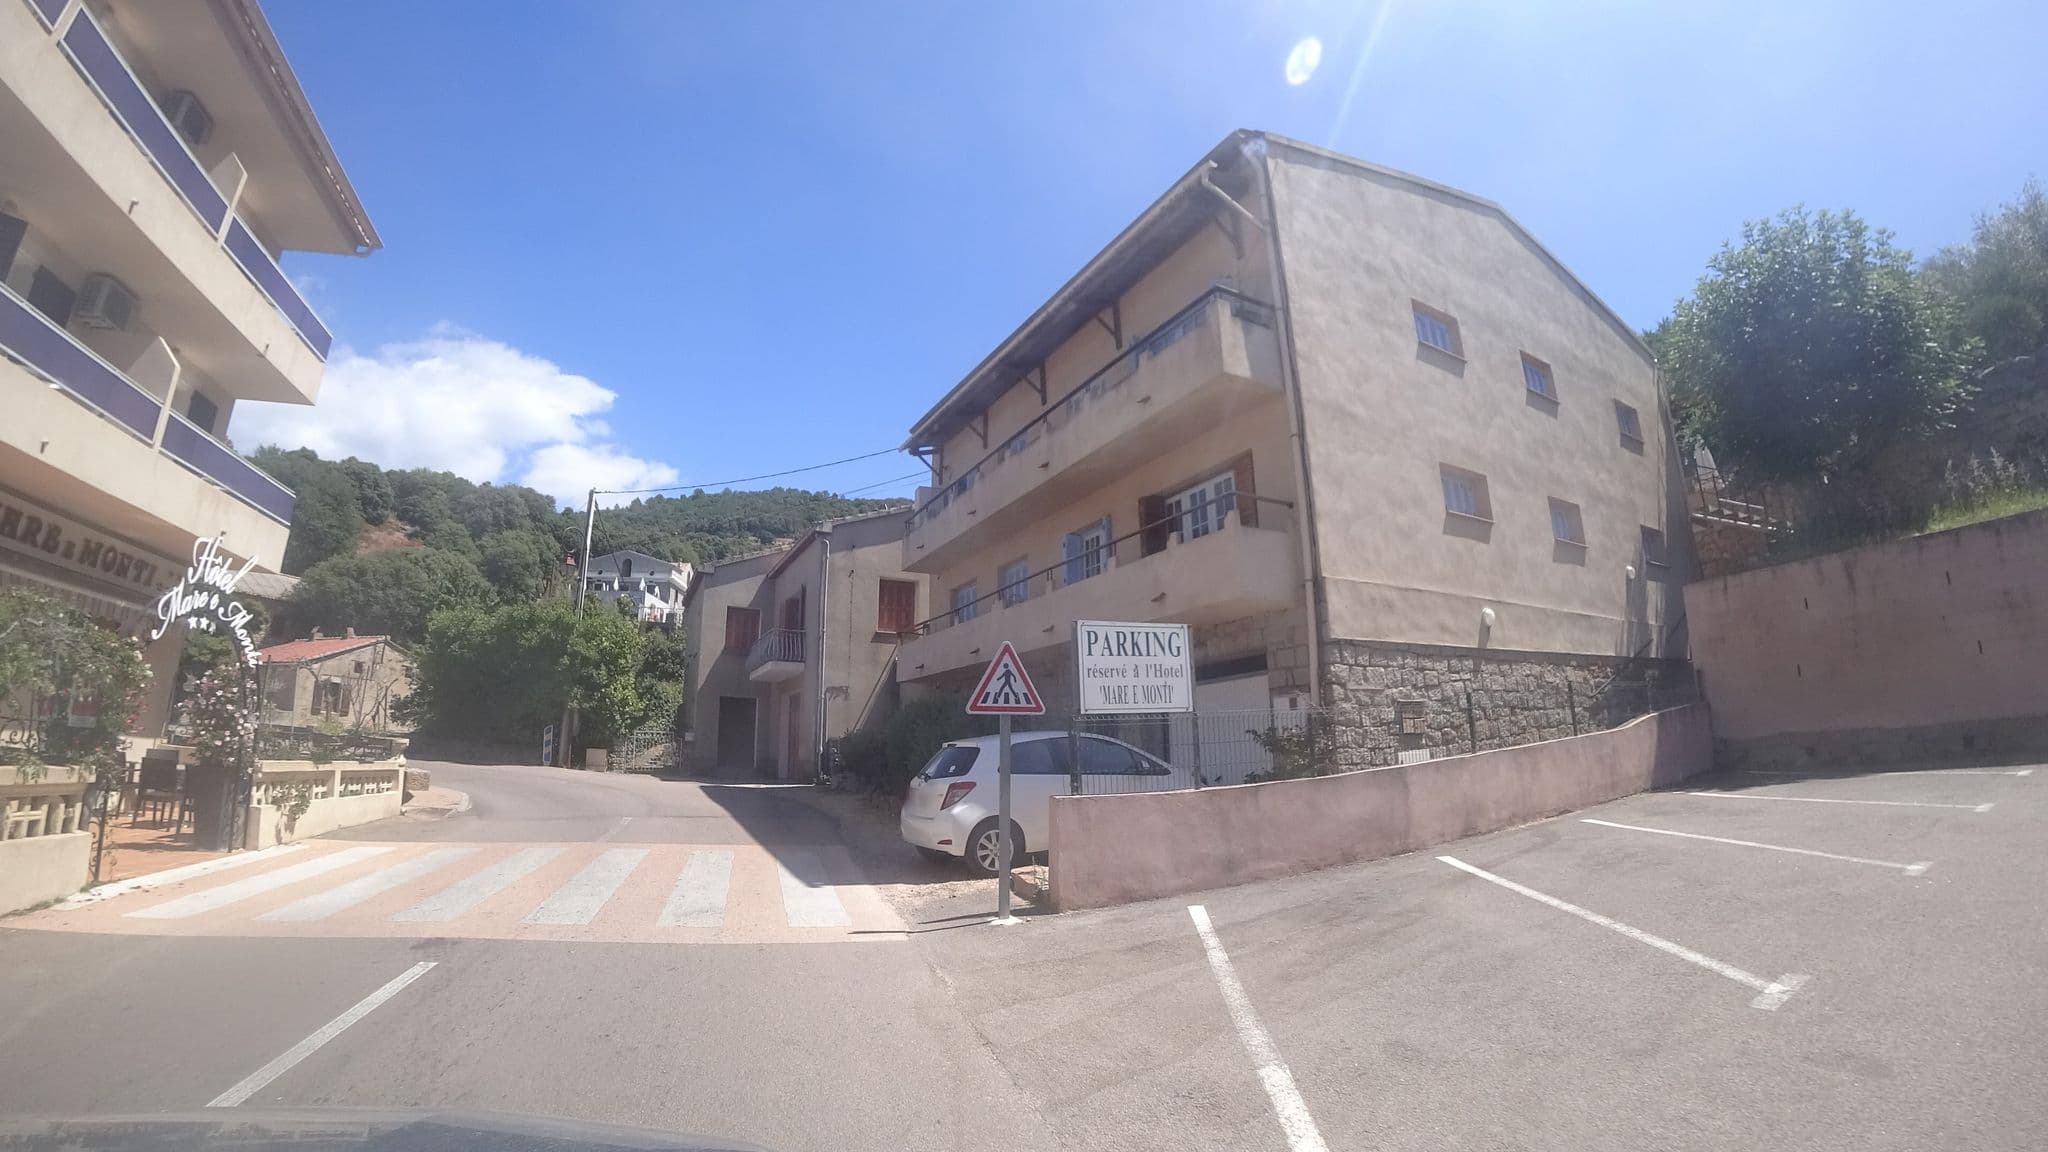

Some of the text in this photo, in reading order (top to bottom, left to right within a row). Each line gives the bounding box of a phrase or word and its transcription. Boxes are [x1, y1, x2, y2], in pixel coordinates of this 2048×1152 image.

[77, 537, 158, 586] MONTI
[187, 536, 259, 594] Hôtel
[151, 577, 263, 668] Mare e Monti
[1085, 630, 1182, 657] PARKING
[1087, 663, 1184, 678] réservé à l'Hotel
[1132, 685, 1139, 704] E
